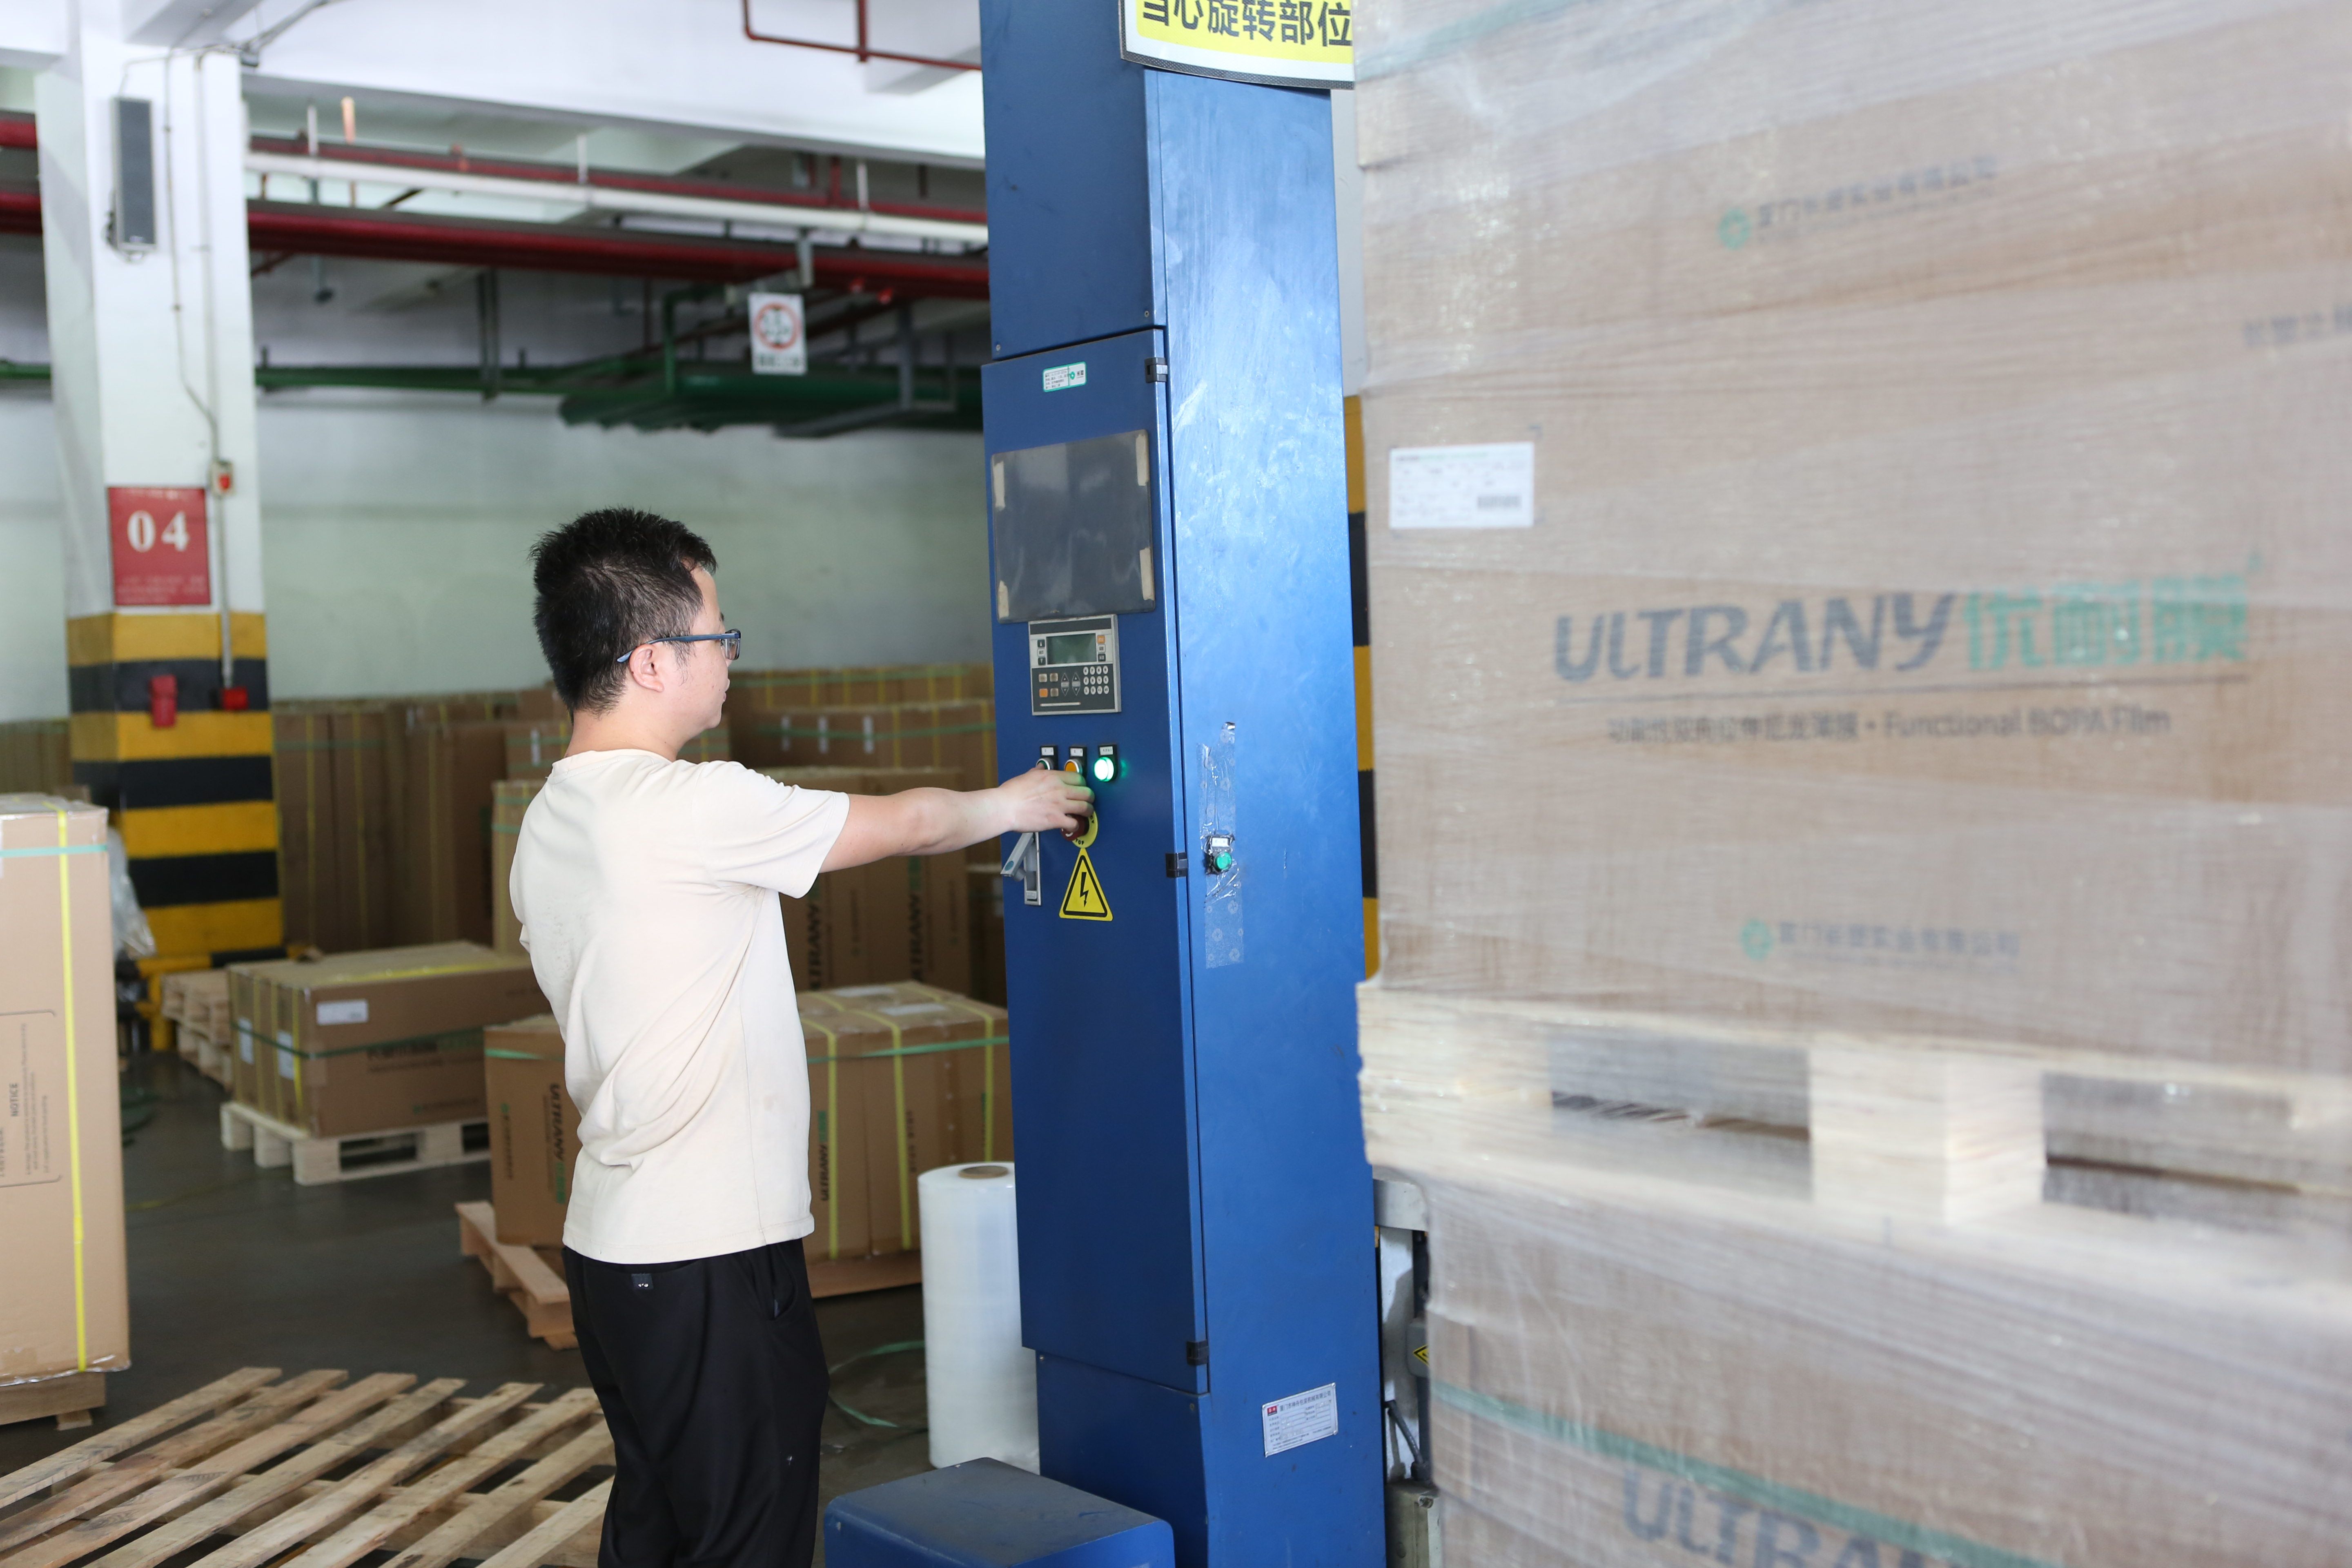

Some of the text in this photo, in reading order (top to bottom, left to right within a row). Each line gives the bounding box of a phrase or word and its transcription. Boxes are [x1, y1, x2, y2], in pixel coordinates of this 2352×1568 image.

[127, 510, 190, 553] 04
[1552, 590, 1959, 684] ULTRANY
[10, 1083, 18, 1116] NOTICE
